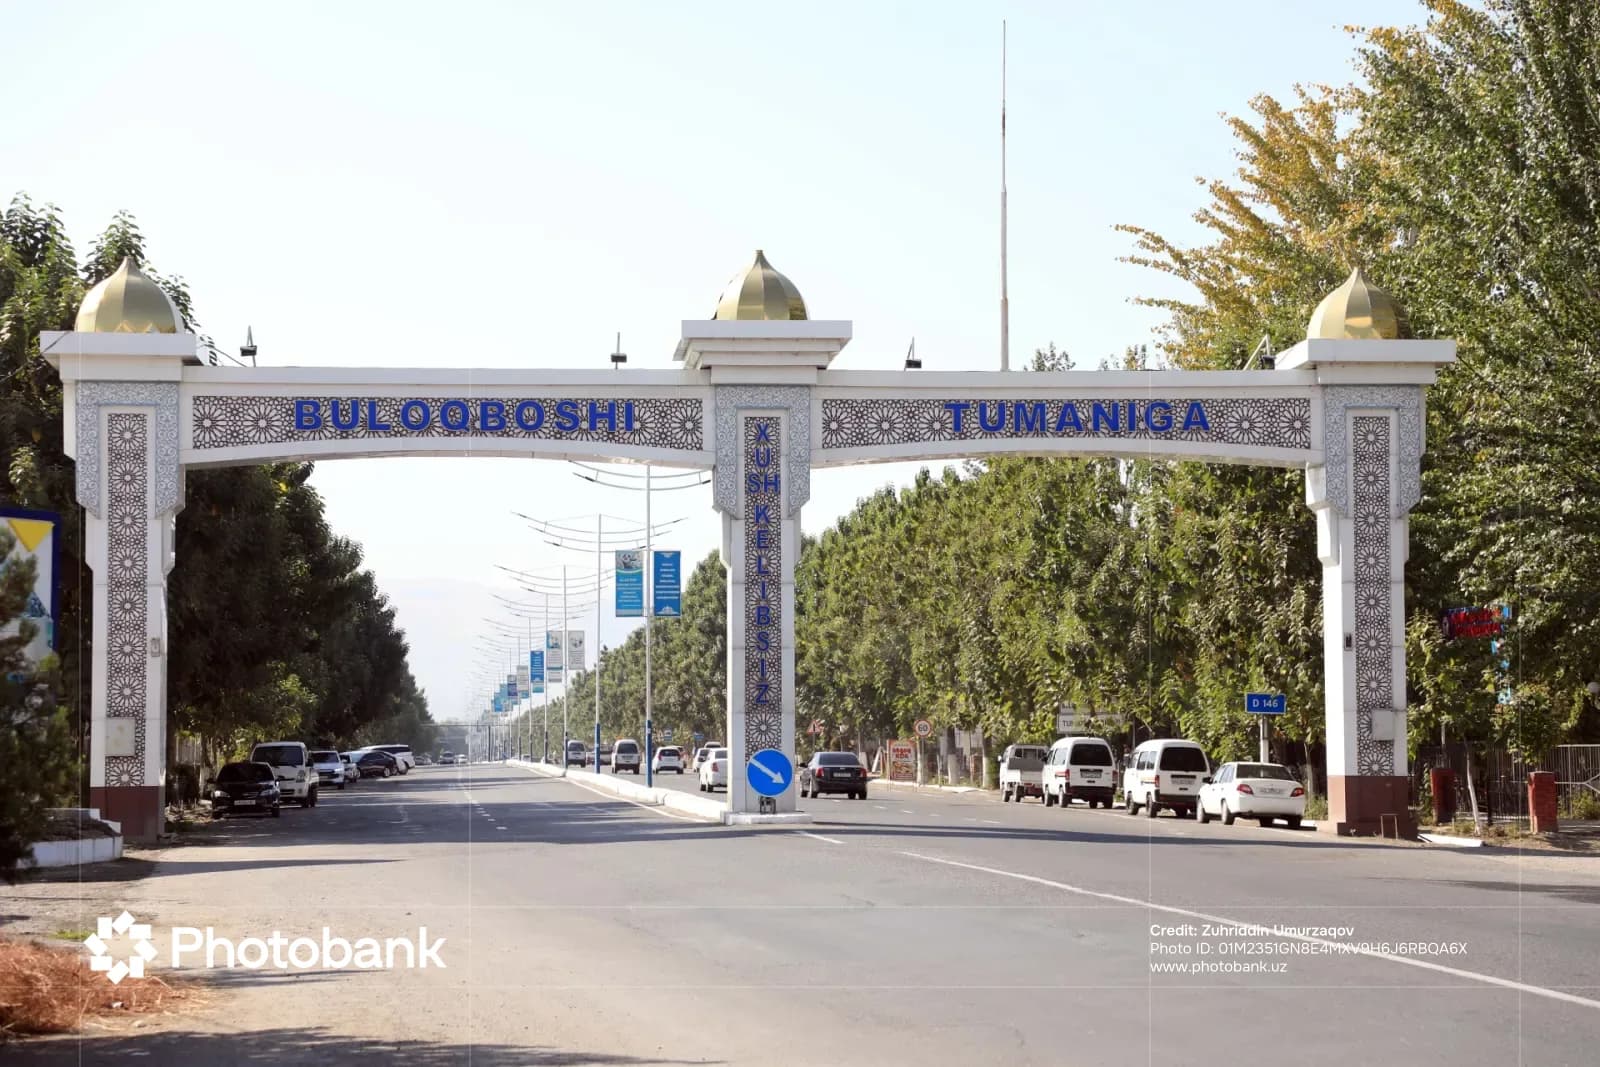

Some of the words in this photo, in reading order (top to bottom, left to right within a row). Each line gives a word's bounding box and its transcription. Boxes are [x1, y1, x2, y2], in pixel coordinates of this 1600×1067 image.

[294, 399, 635, 432] BULOQBOSHI
[944, 401, 1211, 433] TUMANIGA
[747, 422, 781, 494] XUSH
[754, 503, 771, 705] KELIBSIZ
[1252, 698, 1260, 708] D
[1262, 698, 1279, 708] 146
[918, 724, 928, 732] 60
